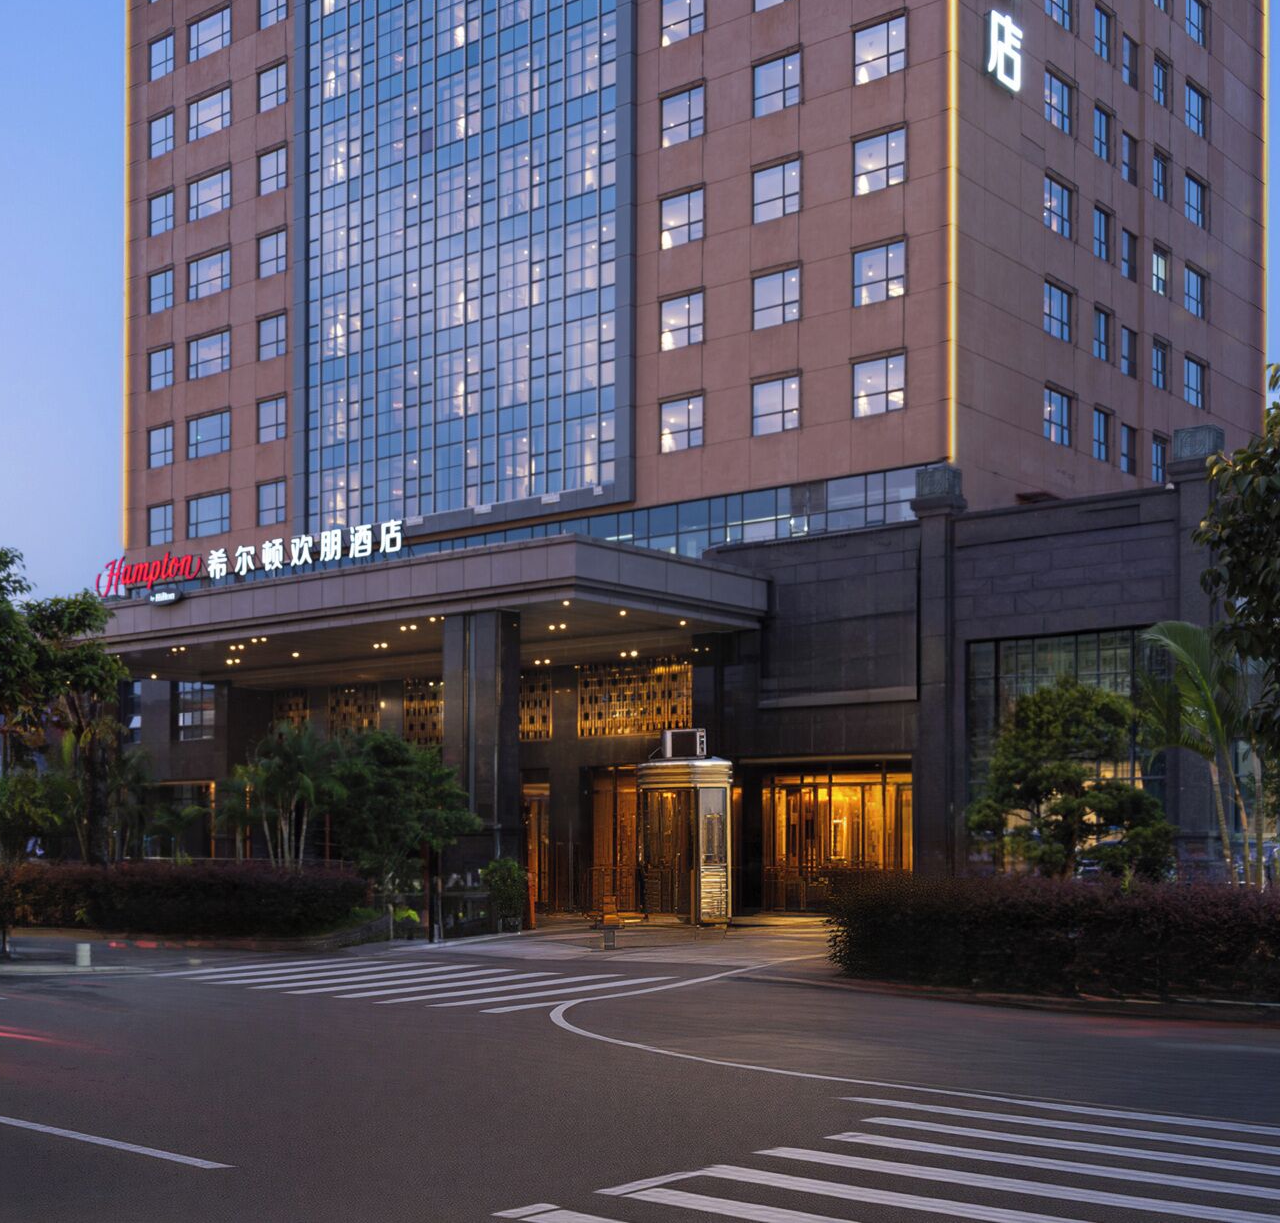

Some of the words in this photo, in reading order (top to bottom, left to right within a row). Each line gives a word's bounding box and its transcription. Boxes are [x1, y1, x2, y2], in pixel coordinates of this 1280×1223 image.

[96, 551, 202, 598] Hampton
[207, 519, 403, 580] 希尔顿欢朋酒店
